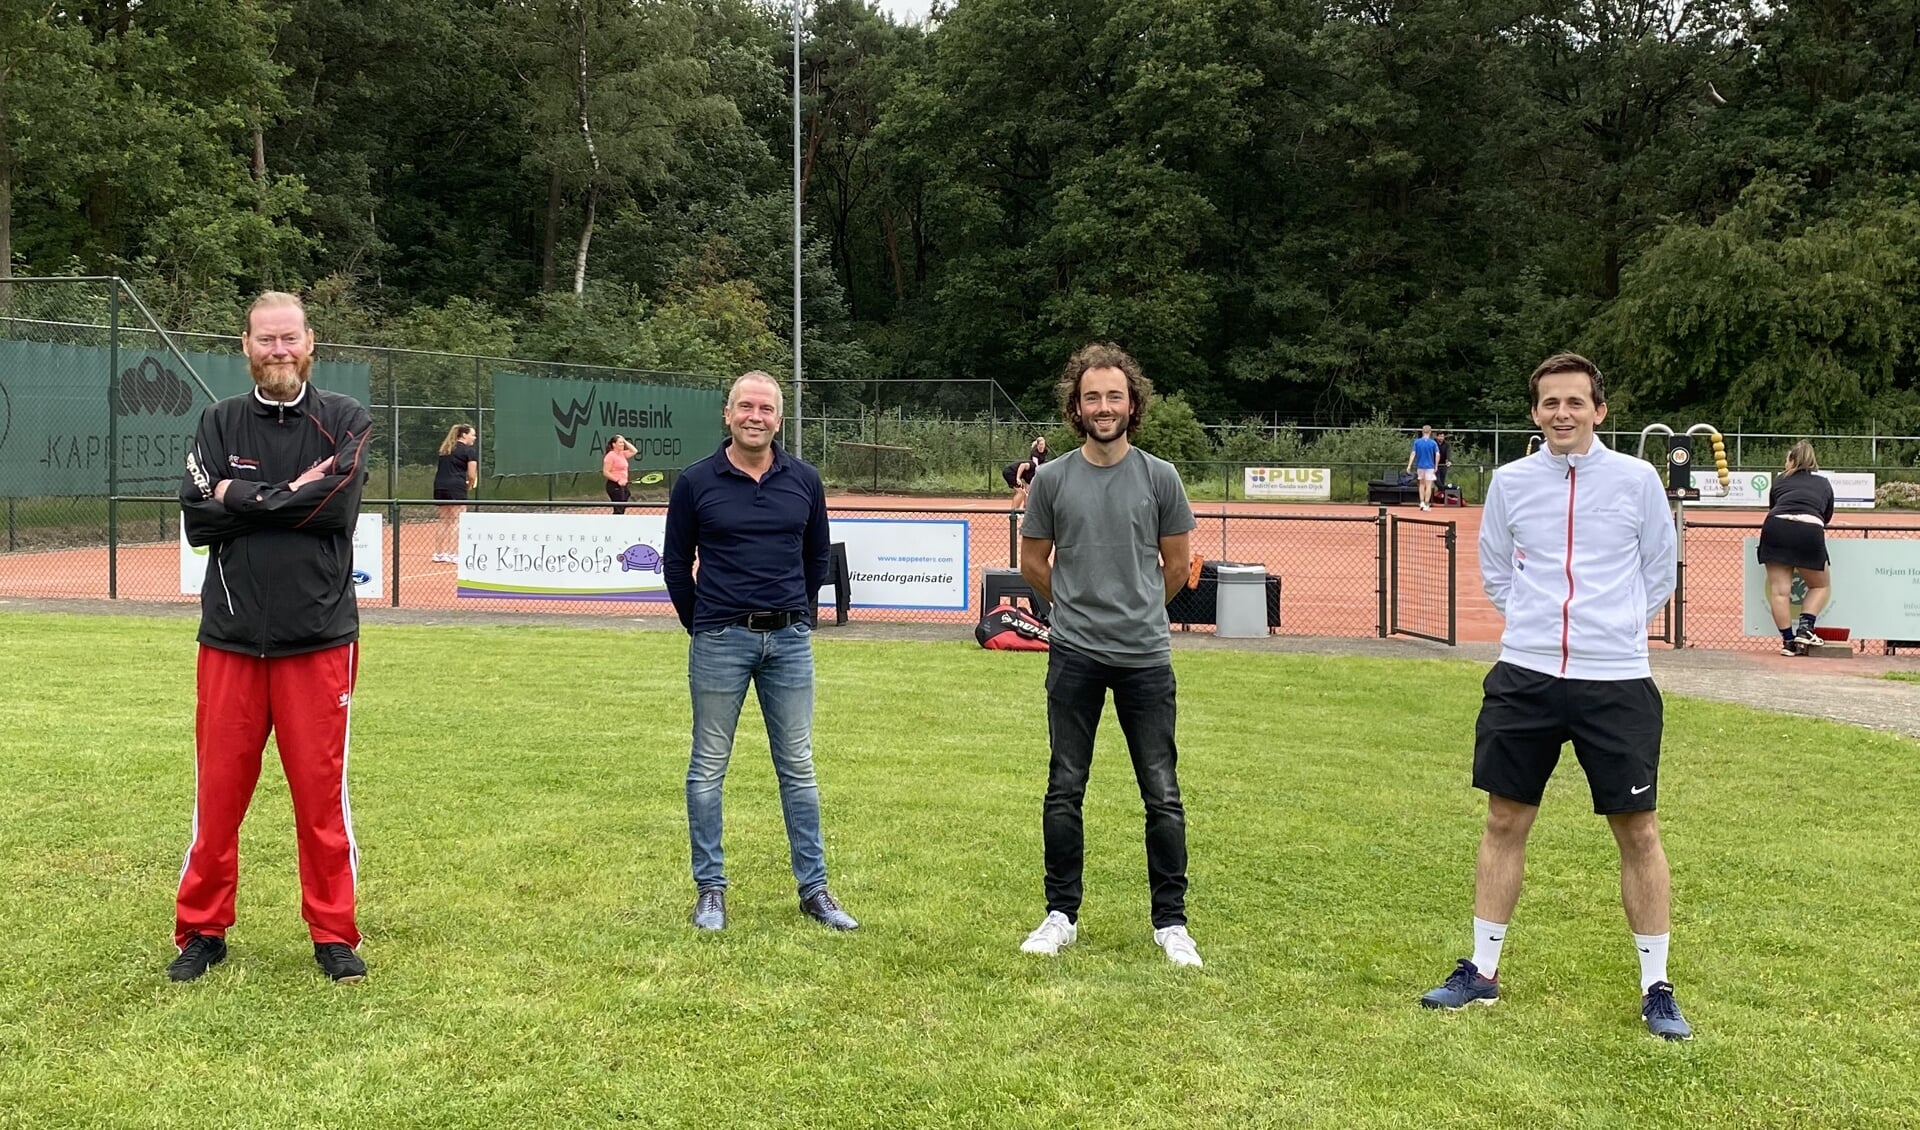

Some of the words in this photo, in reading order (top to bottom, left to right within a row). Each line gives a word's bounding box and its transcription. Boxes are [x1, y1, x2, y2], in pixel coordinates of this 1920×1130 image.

[599, 401, 673, 428] Wassink
[589, 430, 682, 462] Agroep
[1268, 469, 1324, 483] PLUS
[467, 533, 613, 543] KINDERCENTRUM
[465, 544, 488, 571] de
[496, 544, 612, 573] KinderSofa
